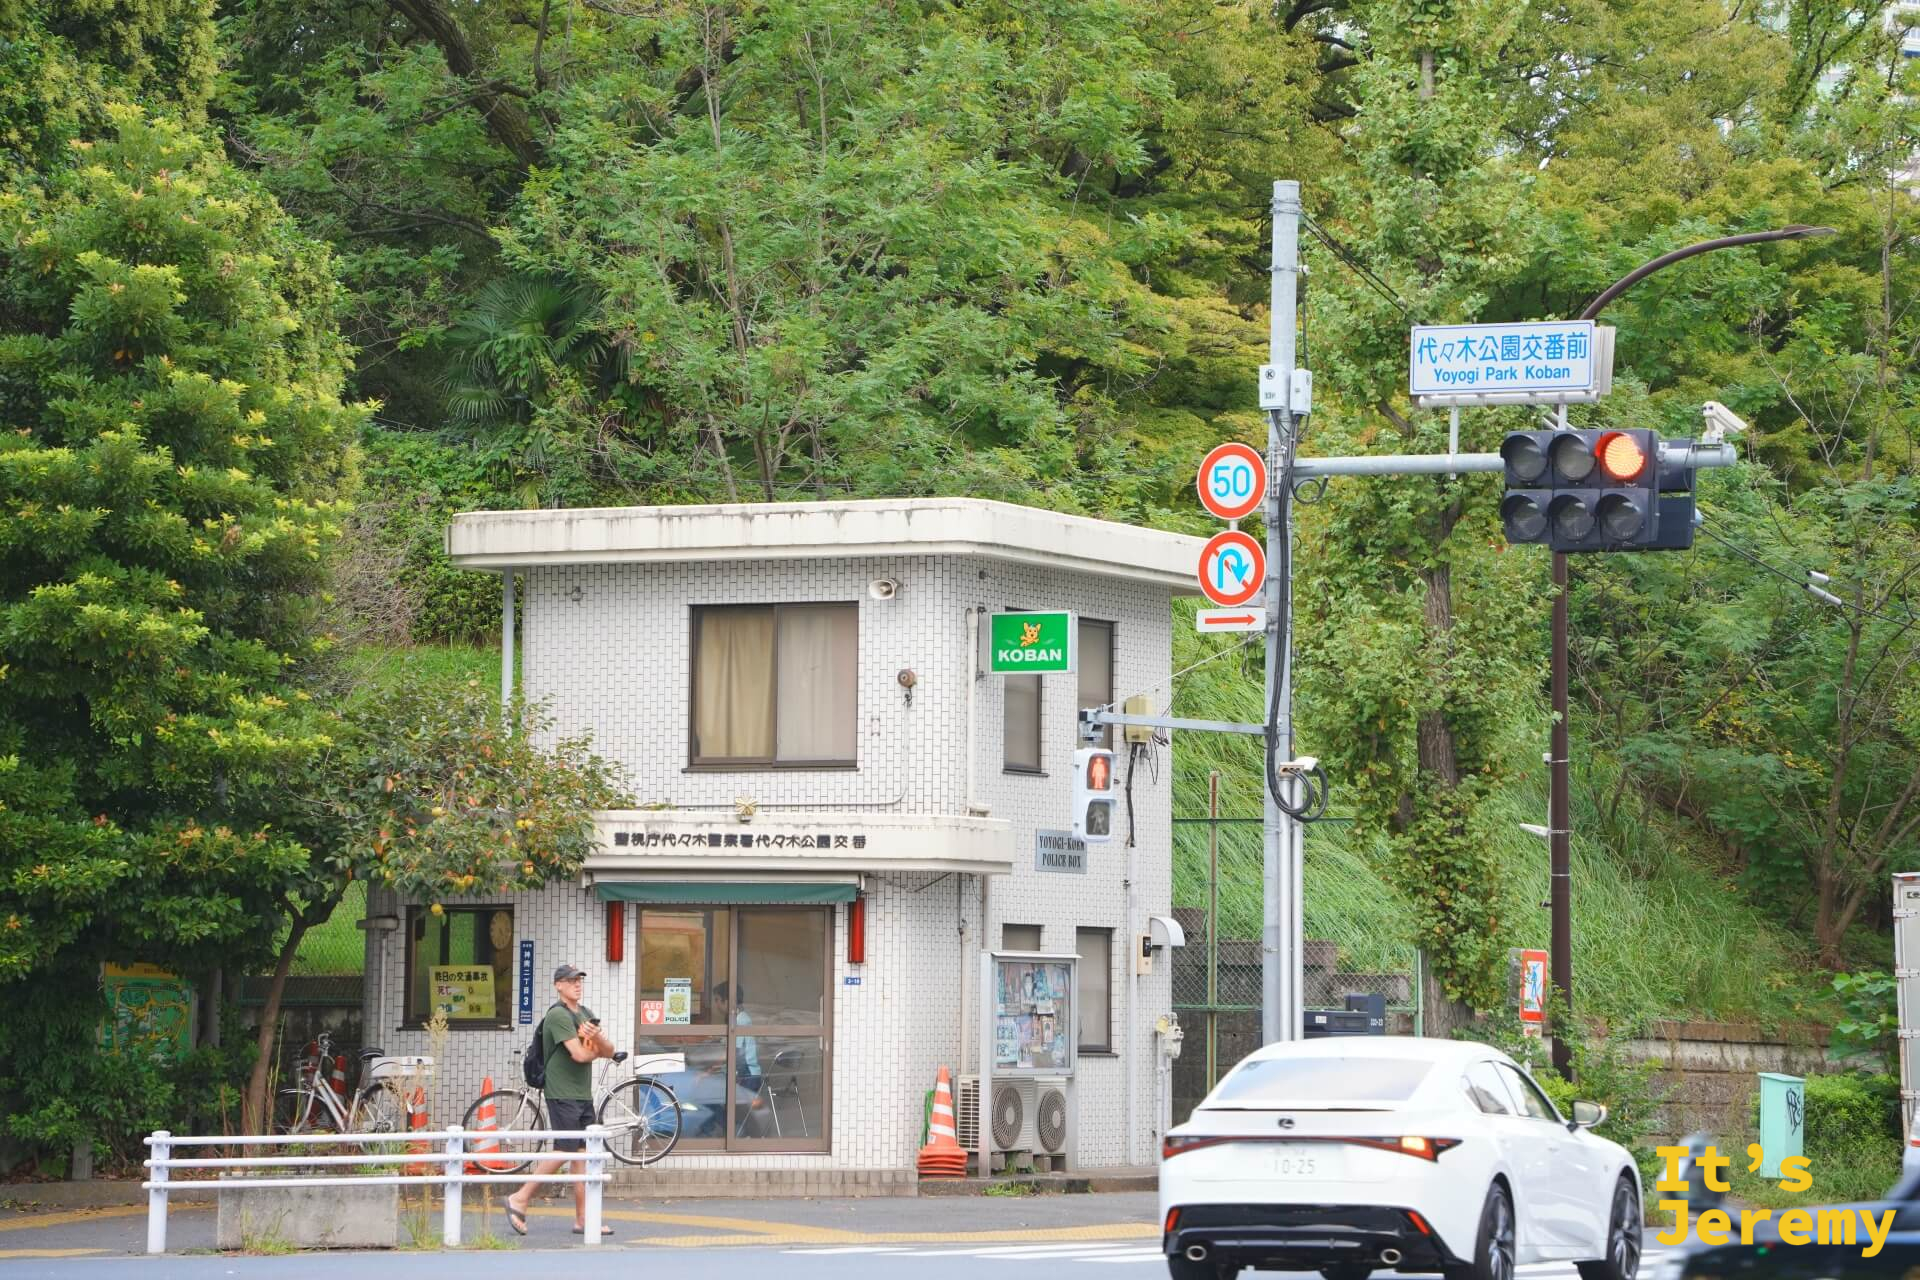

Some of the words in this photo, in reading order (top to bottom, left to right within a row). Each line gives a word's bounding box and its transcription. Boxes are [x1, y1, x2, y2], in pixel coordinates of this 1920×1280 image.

[1418, 332, 1588, 364] 代々木公園交番前
[1434, 367, 1480, 384] Yoyogi
[1485, 365, 1518, 380] Park
[1525, 364, 1570, 379] Koban
[1214, 465, 1250, 497] 50
[998, 648, 1062, 662] KOBAN
[1042, 853, 1067, 867] POLICE
[1068, 855, 1081, 868] BOX
[643, 1002, 663, 1010] AED
